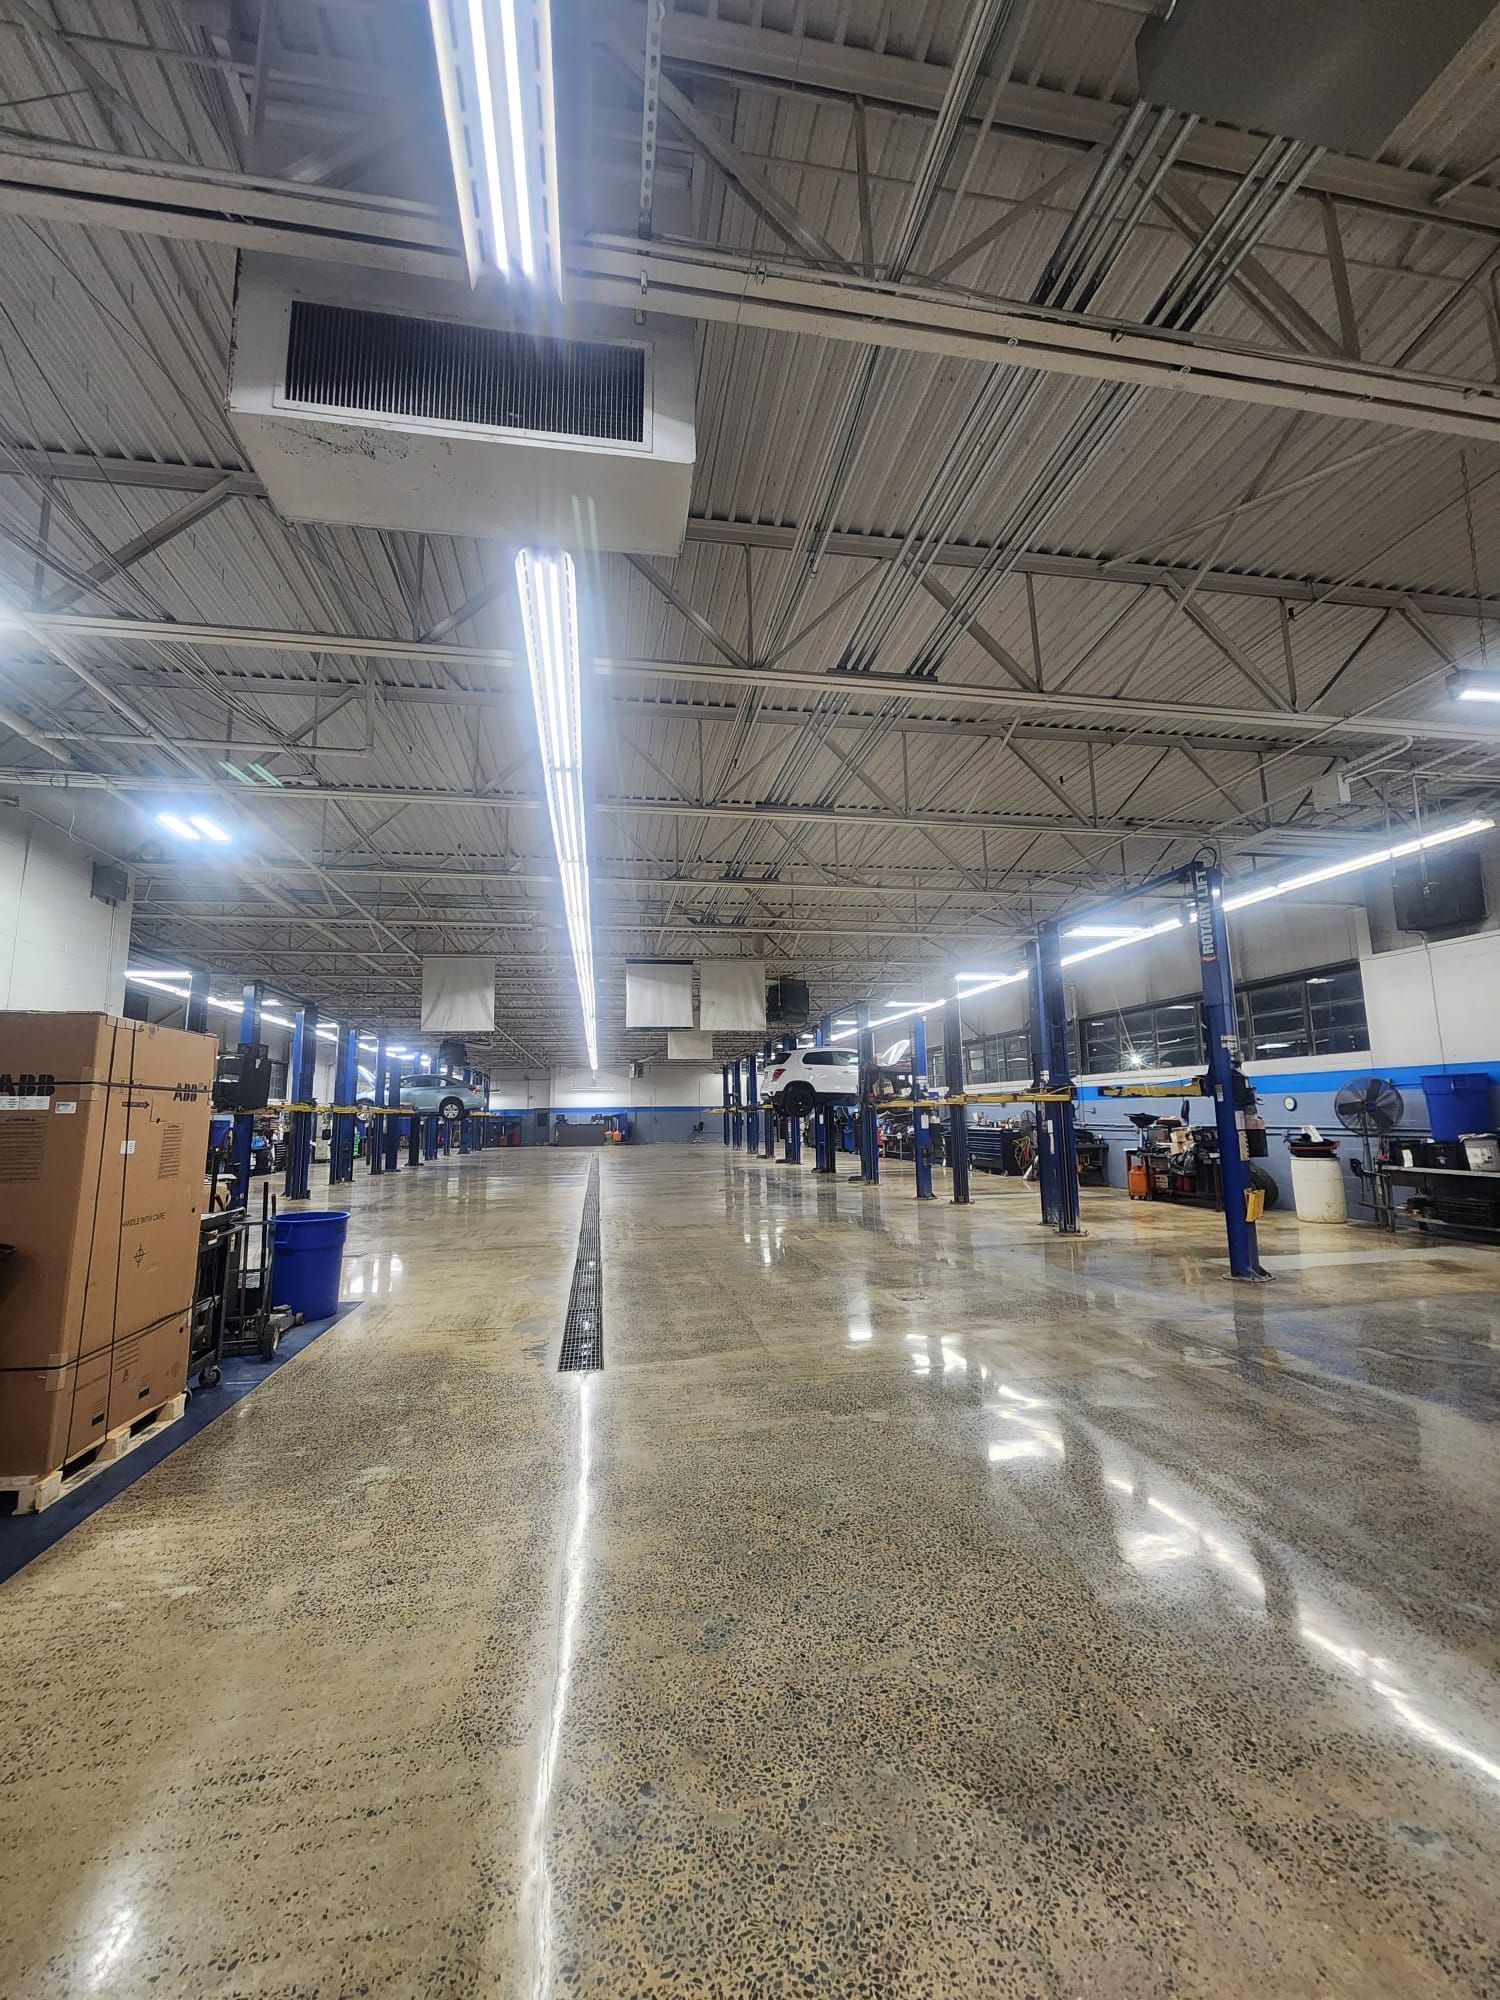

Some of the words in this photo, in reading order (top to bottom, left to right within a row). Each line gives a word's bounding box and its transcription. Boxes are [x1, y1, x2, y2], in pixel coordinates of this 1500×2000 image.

[1196, 871, 1208, 897] LIFT
[1199, 902, 1214, 954] ROTARY
[0, 1074, 55, 1096] ABB
[173, 1082, 198, 1102] ABB
